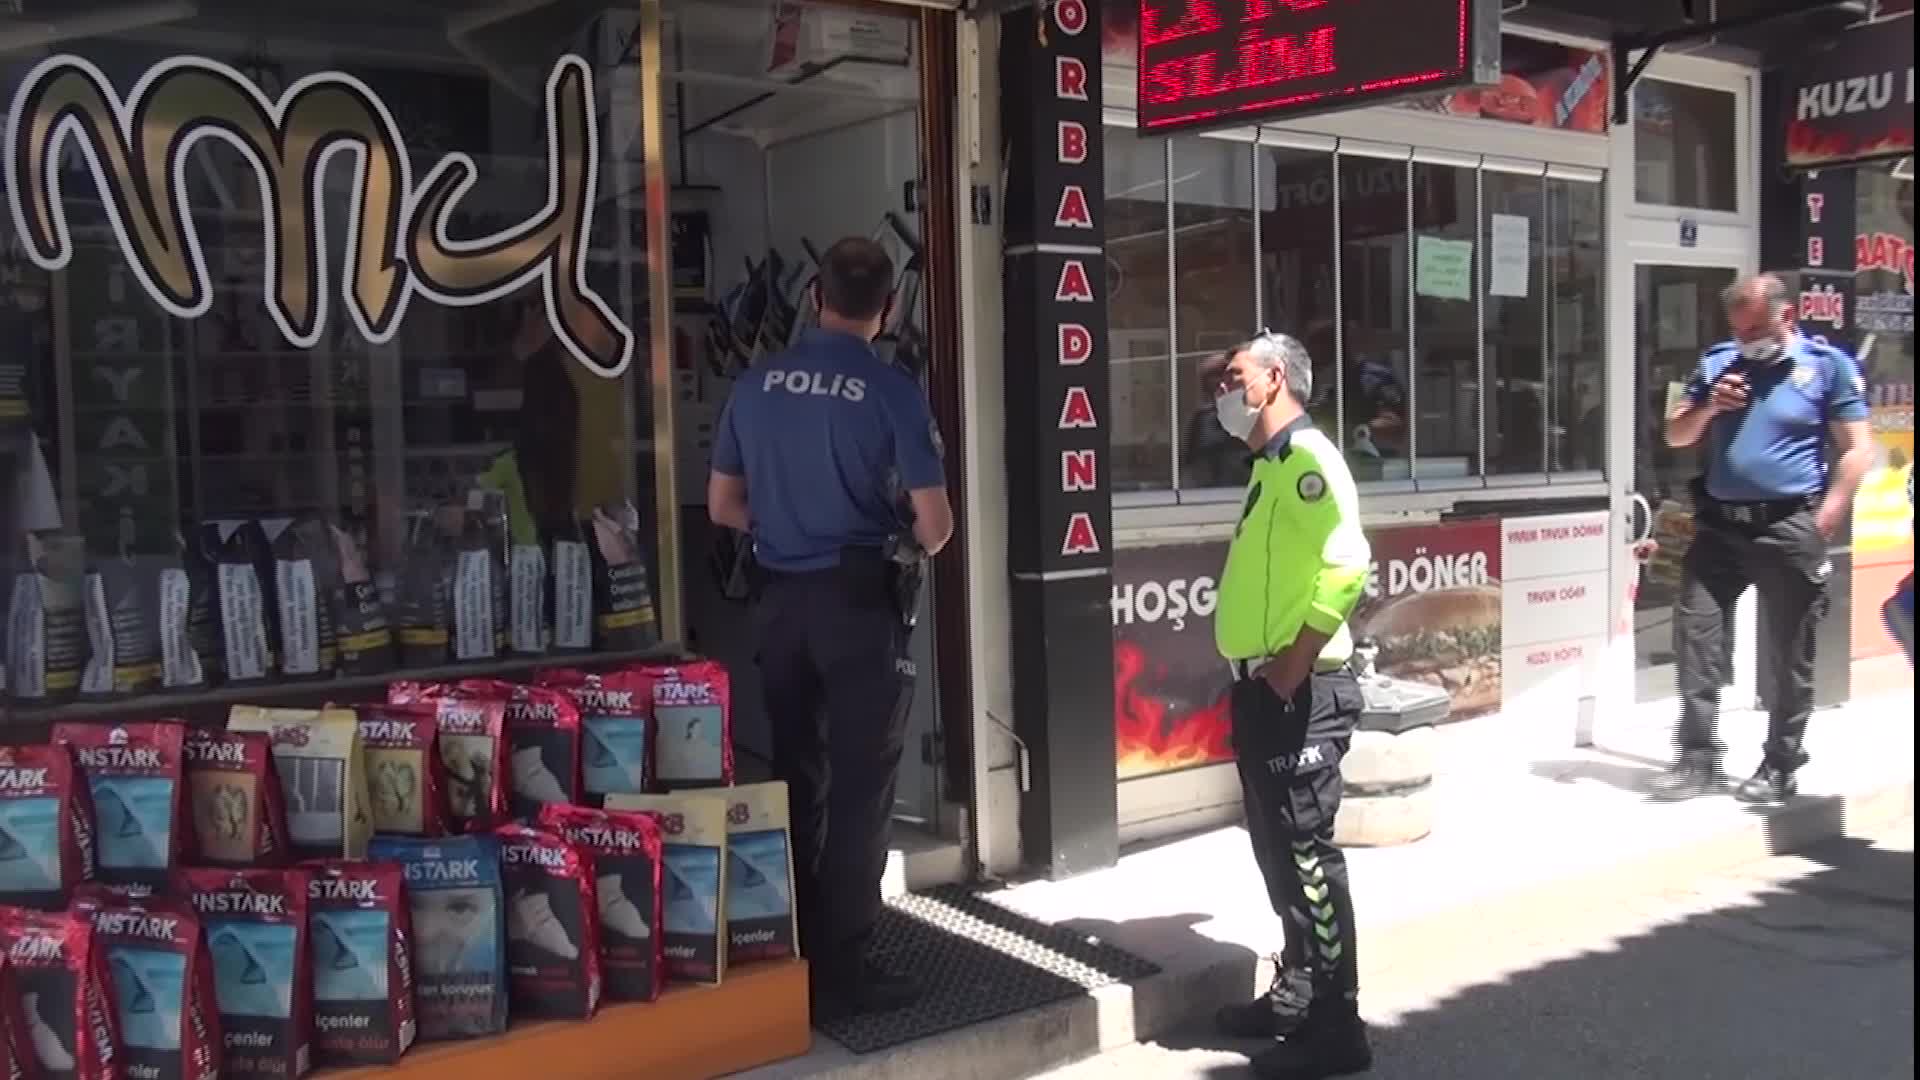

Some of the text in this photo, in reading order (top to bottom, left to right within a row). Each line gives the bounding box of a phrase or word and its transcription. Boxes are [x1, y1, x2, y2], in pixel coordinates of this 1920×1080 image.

[1797, 71, 1893, 120] KUZU
[1806, 171, 1825, 267] TE
[1054, 260, 1100, 555] ADANA
[1389, 548, 1488, 595] DÖNER
[309, 879, 377, 898] STARK
